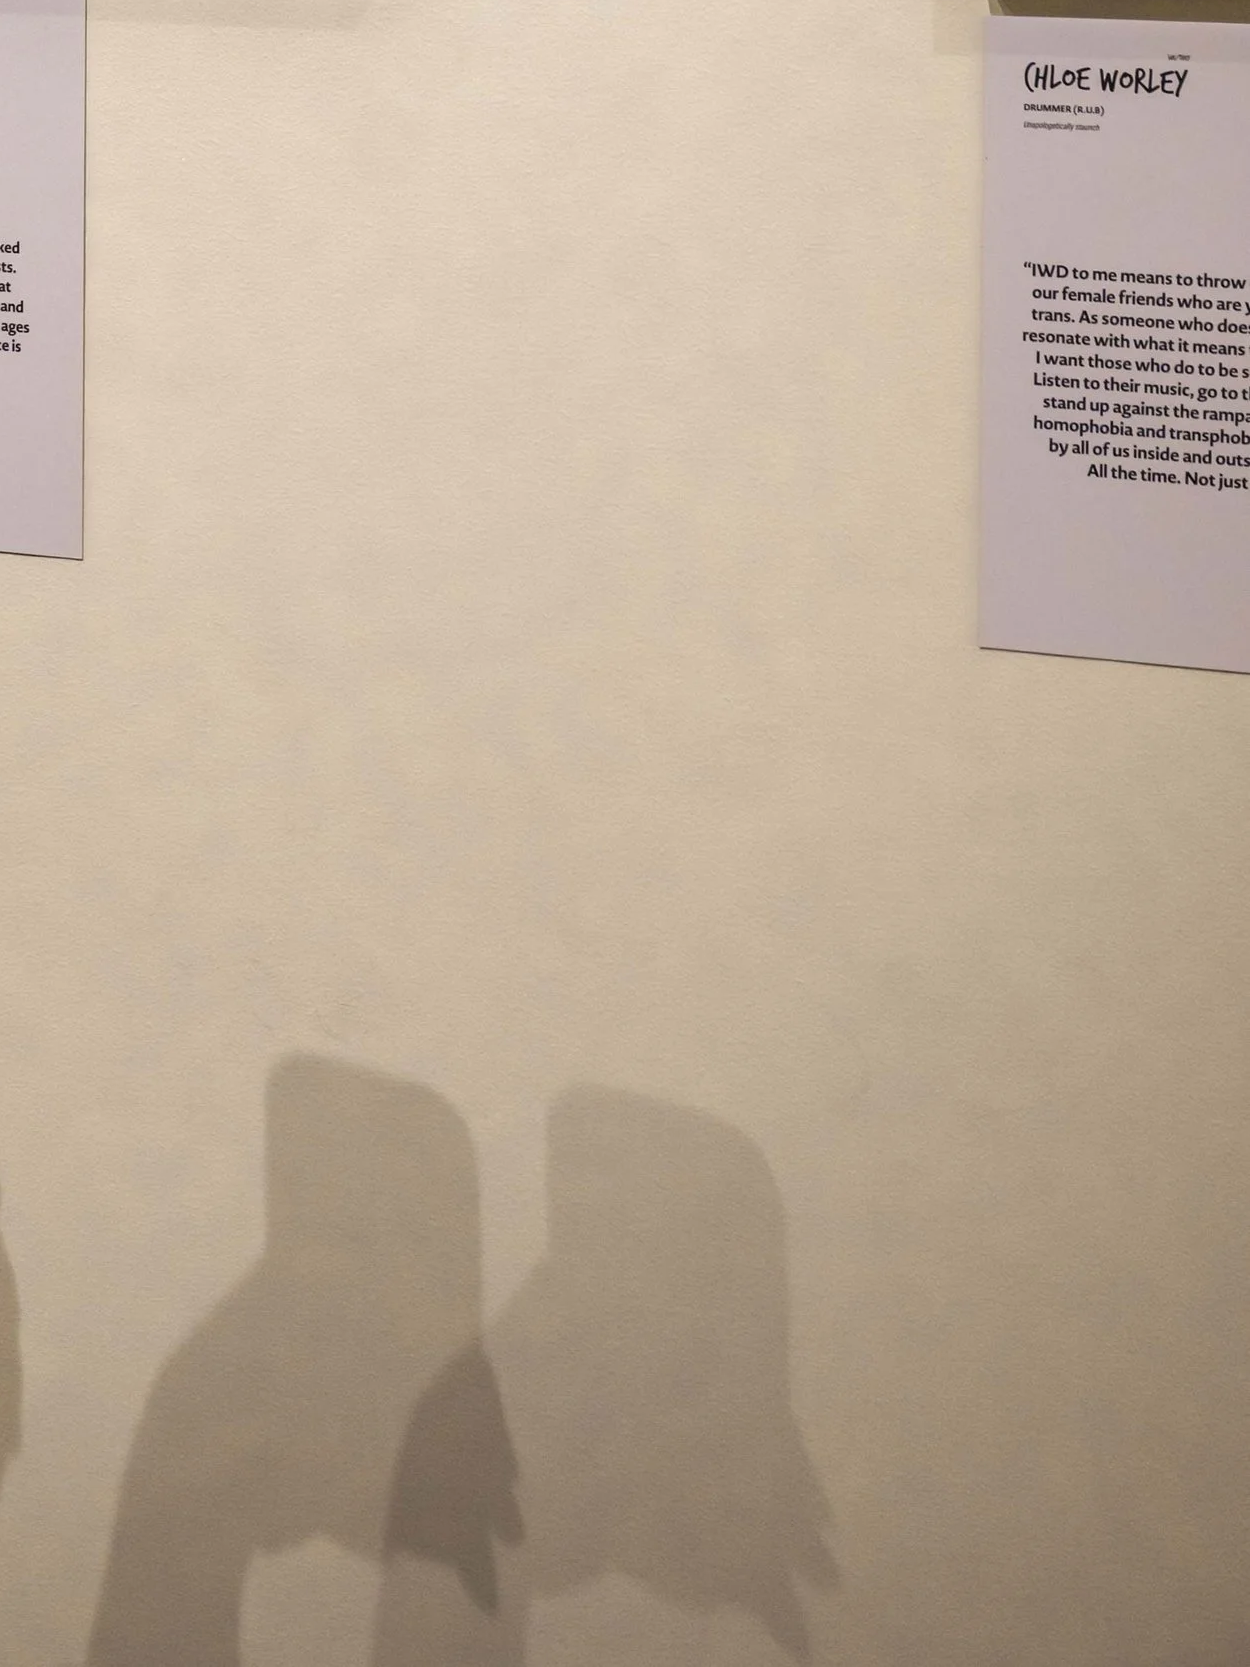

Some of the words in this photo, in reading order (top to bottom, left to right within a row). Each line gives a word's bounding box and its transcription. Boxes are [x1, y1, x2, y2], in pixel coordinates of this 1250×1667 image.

[1024, 62, 1091, 93] CHLOE
[1099, 67, 1189, 98] WORLEY
[1023, 103, 1072, 113] DRUMMER
[1023, 261, 1070, 279] “IWD
[1071, 267, 1090, 280] to
[1092, 270, 1118, 282] me
[1120, 272, 1173, 286] means
[1175, 273, 1194, 287] to
[1196, 272, 1247, 290] throw
[0, 300, 24, 313] and
[1031, 288, 1060, 300] our
[1061, 285, 1116, 304] female
[1118, 289, 1174, 308] friends
[1176, 294, 1214, 310] who
[1216, 299, 1242, 312] are
[0, 322, 30, 337] ages
[1031, 308, 1076, 323] trans.
[1078, 309, 1099, 325] As
[1101, 314, 1175, 330] someone
[1177, 316, 1214, 332] who
[11, 338, 22, 353] is
[1022, 331, 1091, 346] resonate
[1093, 332, 1131, 349] with
[1133, 335, 1176, 352] what
[1178, 337, 1190, 353] it
[1192, 342, 1246, 356] means
[1036, 350, 1041, 364] I
[1043, 354, 1085, 368] want
[1087, 353, 1133, 371] those
[1134, 357, 1171, 373] who
[1173, 359, 1195, 375] do
[1197, 363, 1216, 377] to
[1218, 362, 1239, 378] be
[1033, 371, 1081, 389] Listen
[1082, 377, 1101, 390] to
[1102, 376, 1141, 393] their
[1143, 381, 1195, 400] music,
[1196, 387, 1218, 403] go
[1220, 386, 1239, 400] to
[1043, 396, 1087, 411] stand
[1089, 401, 1110, 417] up
[1112, 401, 1170, 419] against
[1172, 403, 1200, 420] the
[1033, 414, 1134, 437] homophobia
[1136, 424, 1166, 439] and
[1049, 437, 1069, 457] by
[1071, 439, 1090, 455] all
[1092, 441, 1111, 456] of
[1112, 446, 1130, 458] us
[1133, 444, 1180, 462] inside
[1182, 449, 1213, 465] and
[1087, 463, 1108, 478] All
[1110, 464, 1138, 481] the
[1140, 467, 1182, 484] time.
[1184, 471, 1216, 487] Not
[1217, 473, 1249, 492] just
